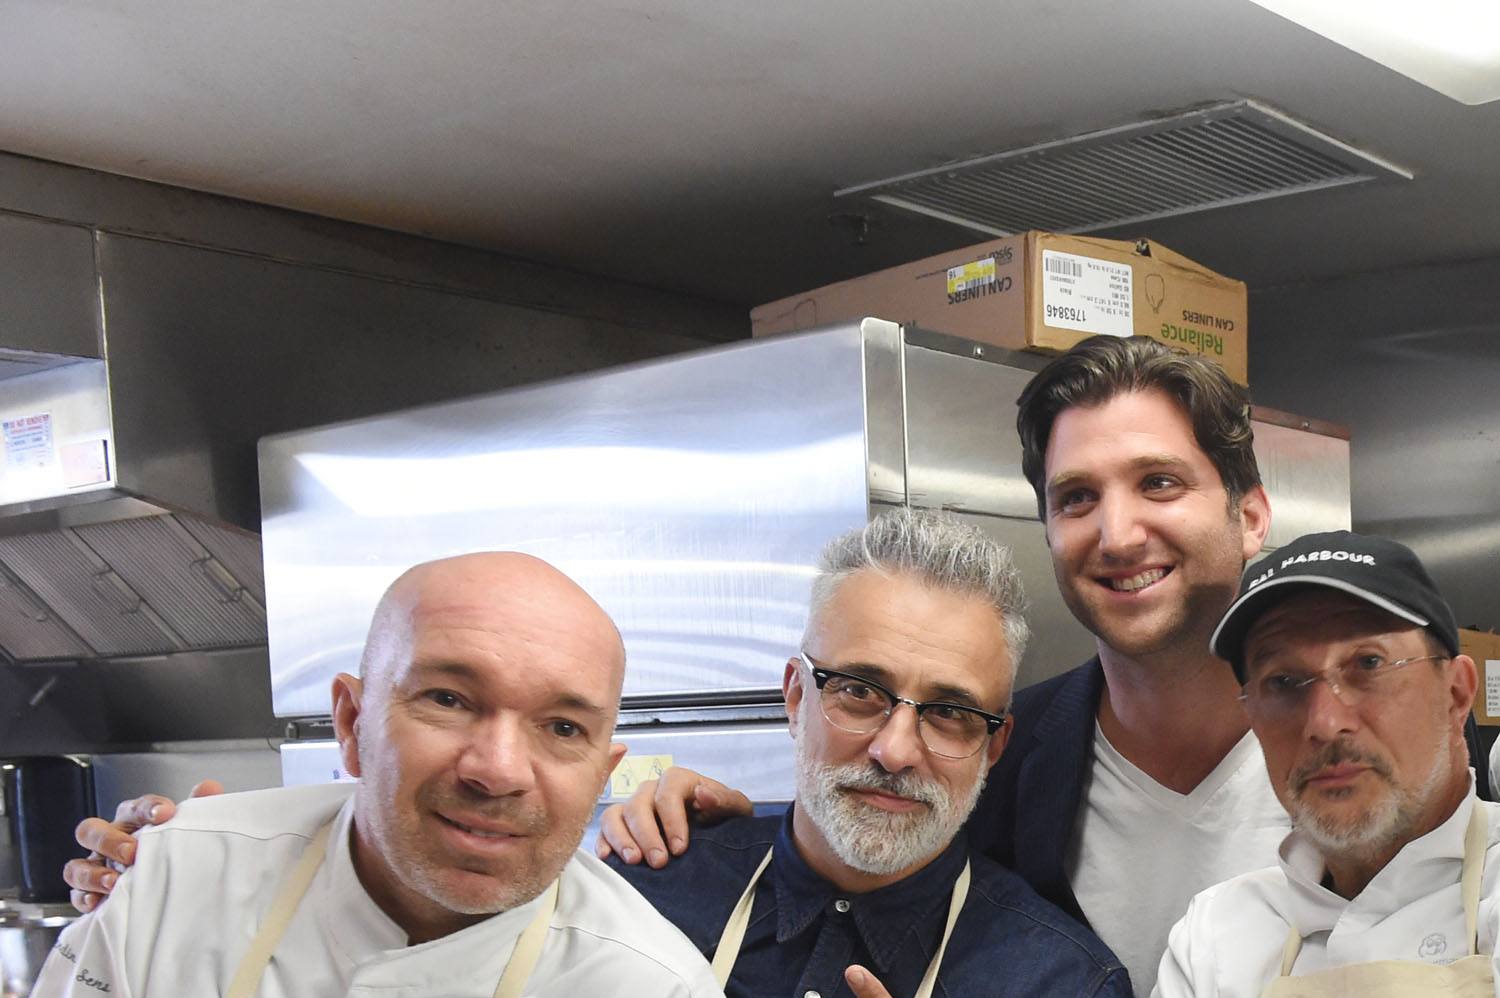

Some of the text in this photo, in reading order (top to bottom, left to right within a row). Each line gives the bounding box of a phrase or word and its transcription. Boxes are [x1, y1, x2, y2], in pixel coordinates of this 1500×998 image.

[948, 277, 1012, 305] CAN LINERS
[1047, 304, 1086, 322] 1763846
[1182, 310, 1234, 331] CAN LINERS
[1161, 323, 1223, 355] Reliance
[1281, 550, 1376, 570] HARBOUR
[76, 969, 111, 992] Sens
